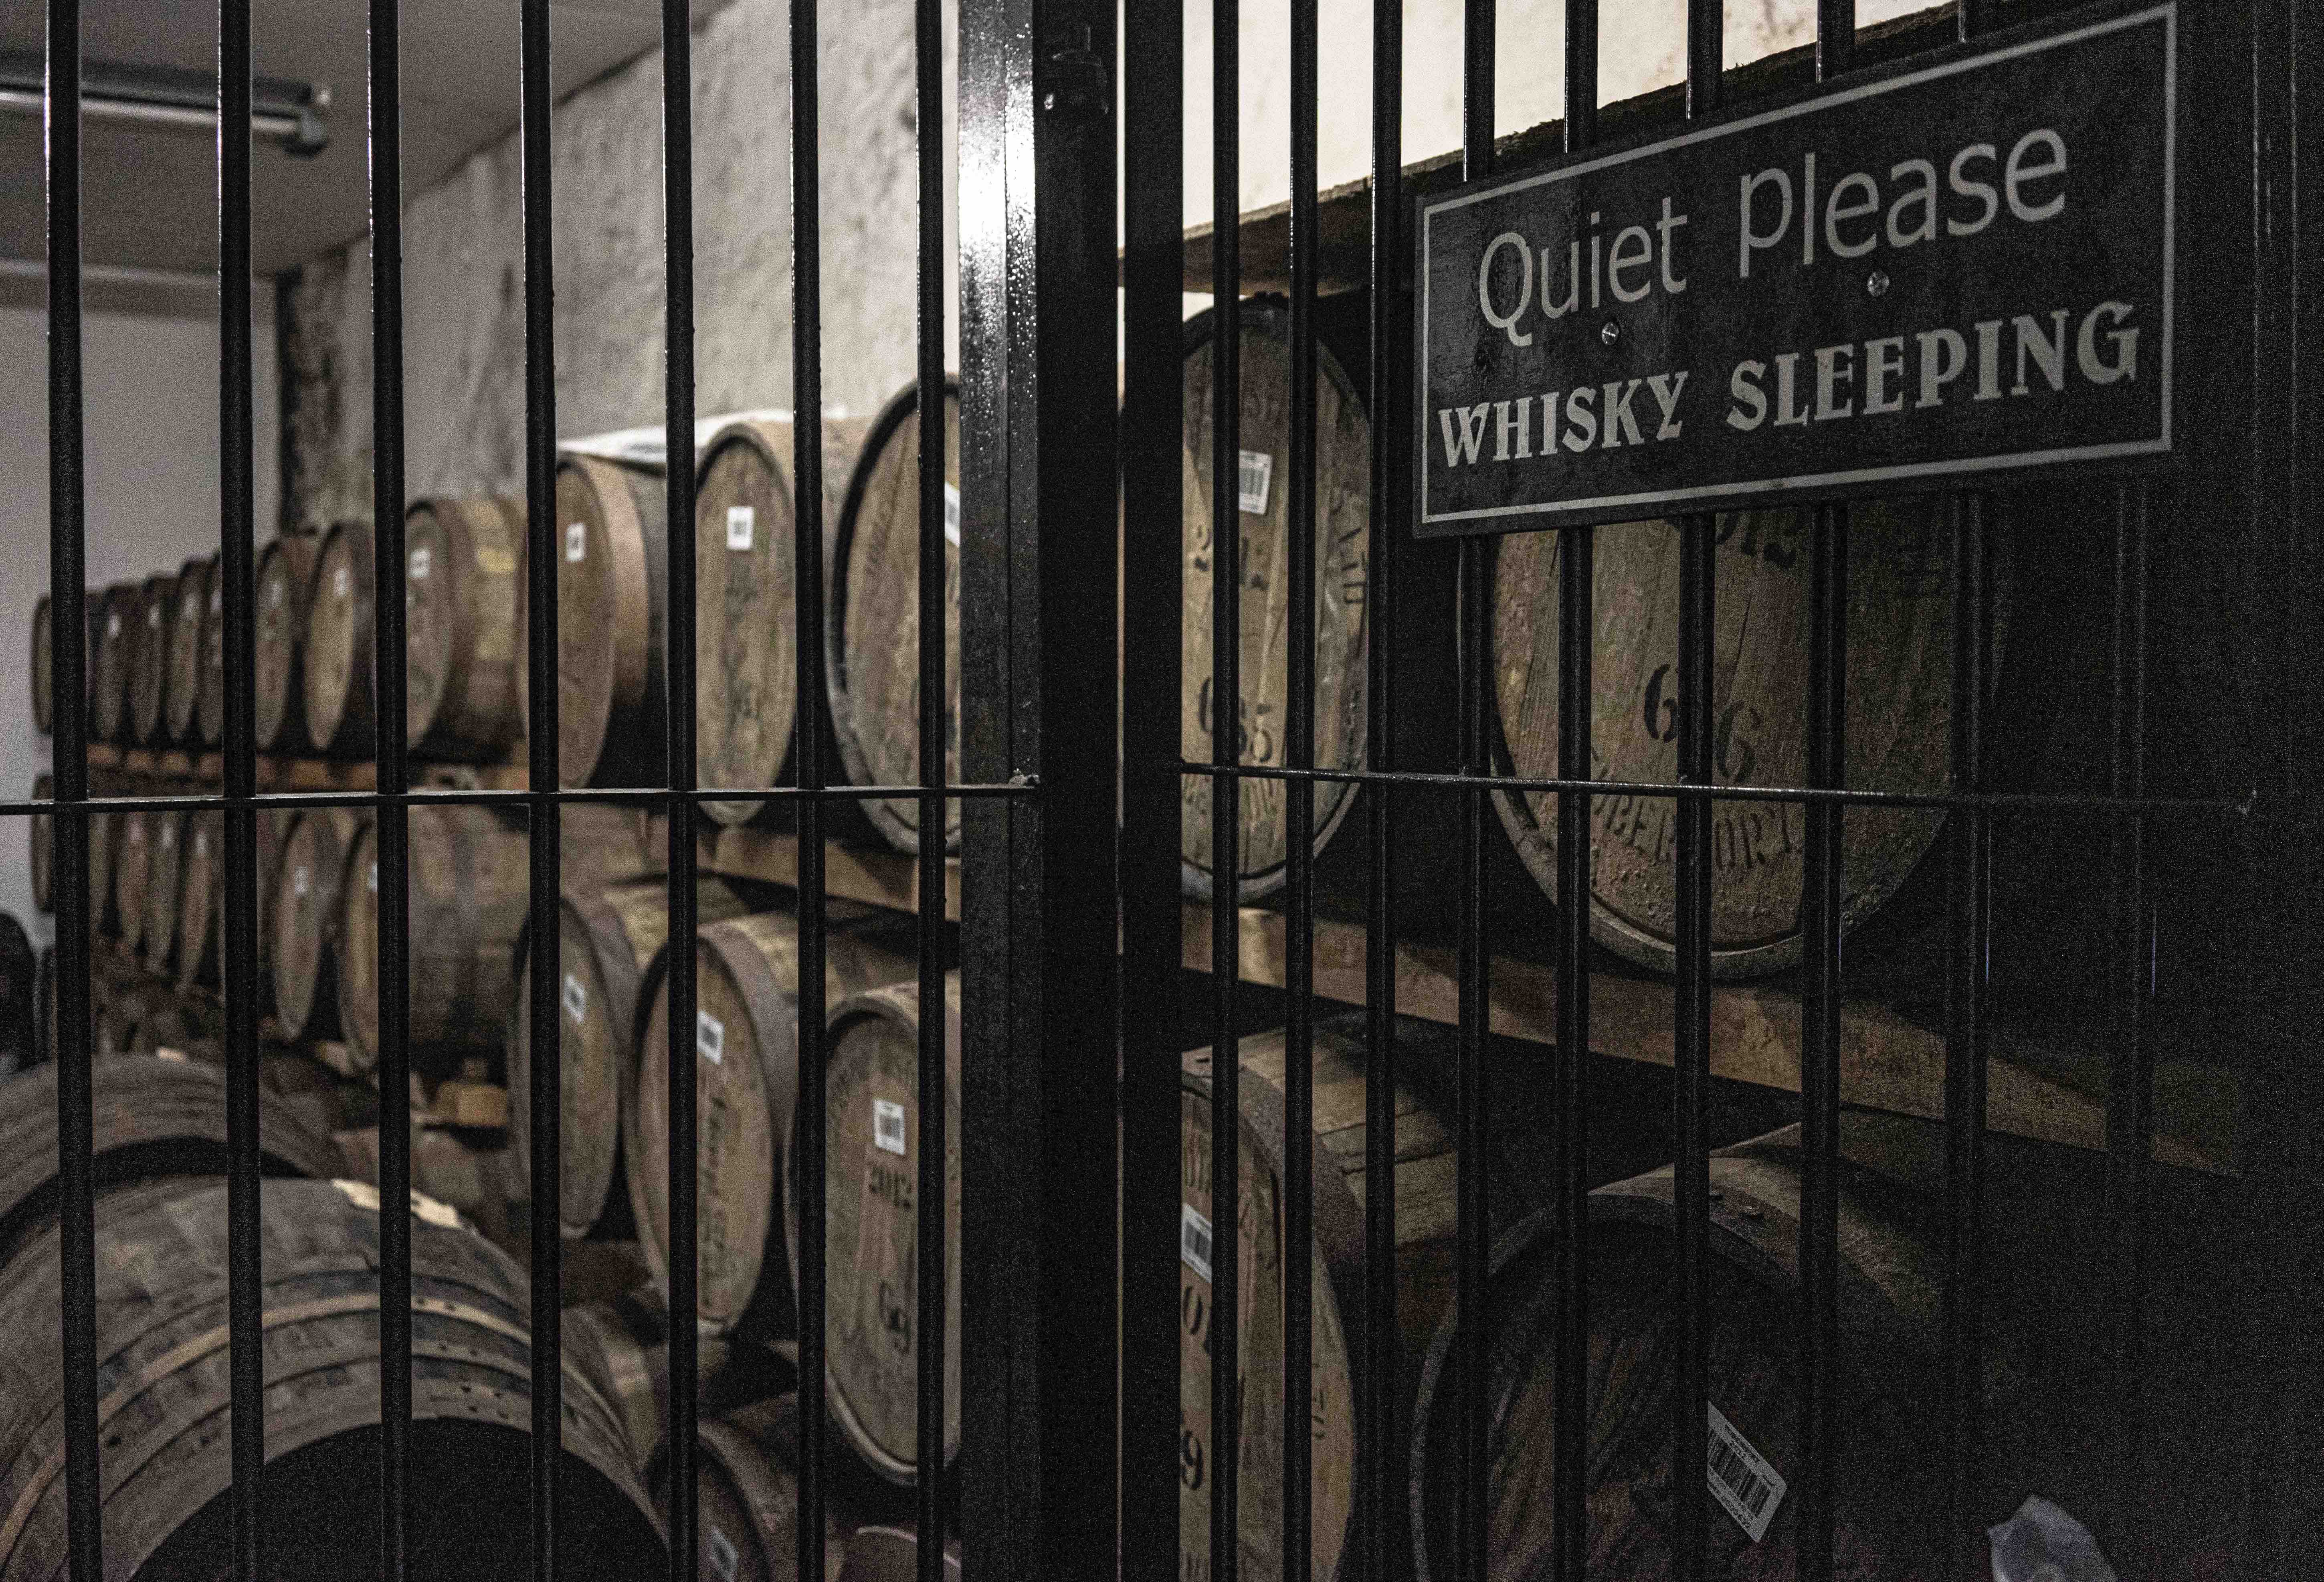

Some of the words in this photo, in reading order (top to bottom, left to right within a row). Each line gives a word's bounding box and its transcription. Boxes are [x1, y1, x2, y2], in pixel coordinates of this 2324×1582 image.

[1479, 196, 1687, 347] Quiet
[1739, 128, 2067, 279] please
[1438, 370, 1689, 468] WHISKY
[1726, 300, 2140, 432] SLEEPING
